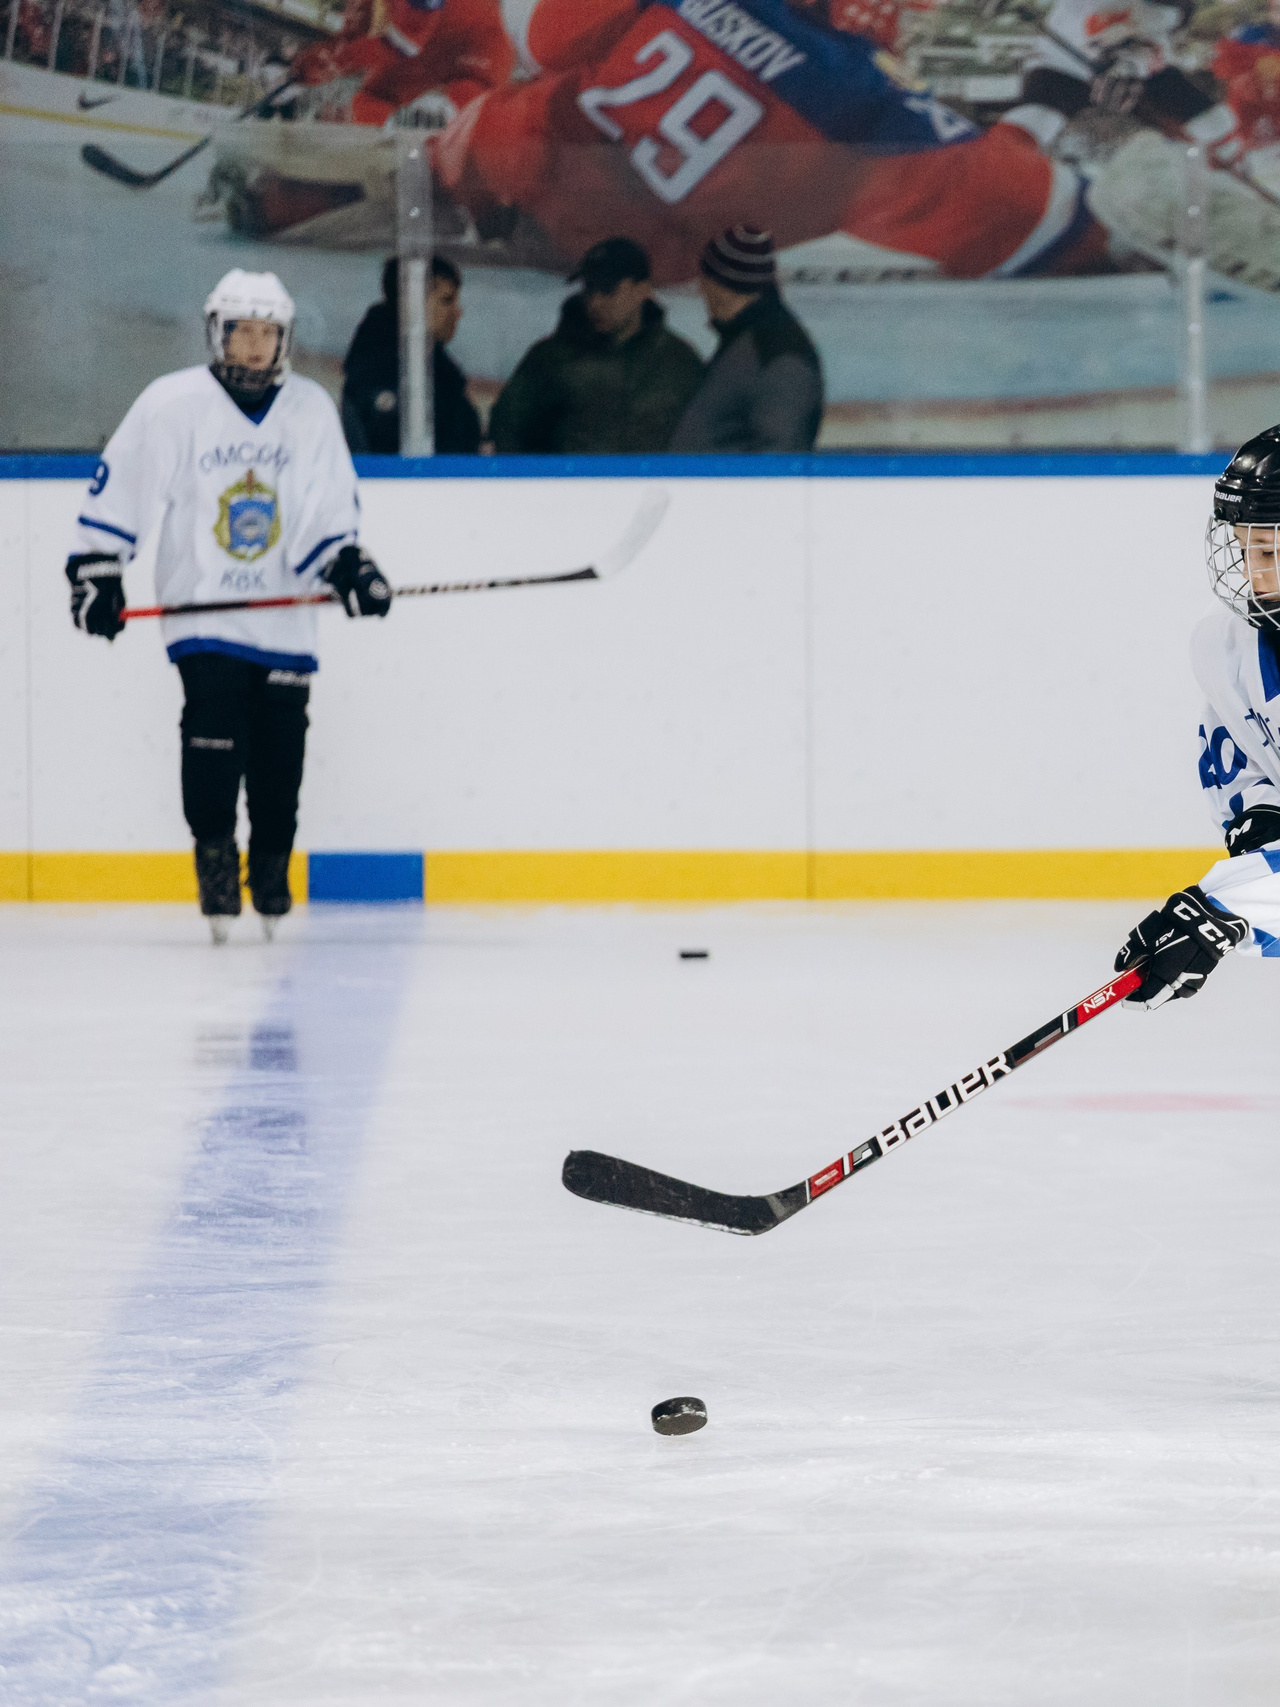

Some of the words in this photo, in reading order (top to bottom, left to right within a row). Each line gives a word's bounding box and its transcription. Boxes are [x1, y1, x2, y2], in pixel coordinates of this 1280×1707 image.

[576, 28, 765, 203] 29
[1214, 490, 1243, 503] BAUER
[1172, 900, 1235, 955] CCM
[1083, 987, 1117, 1014] NSX
[876, 1051, 1012, 1156] BAUER
